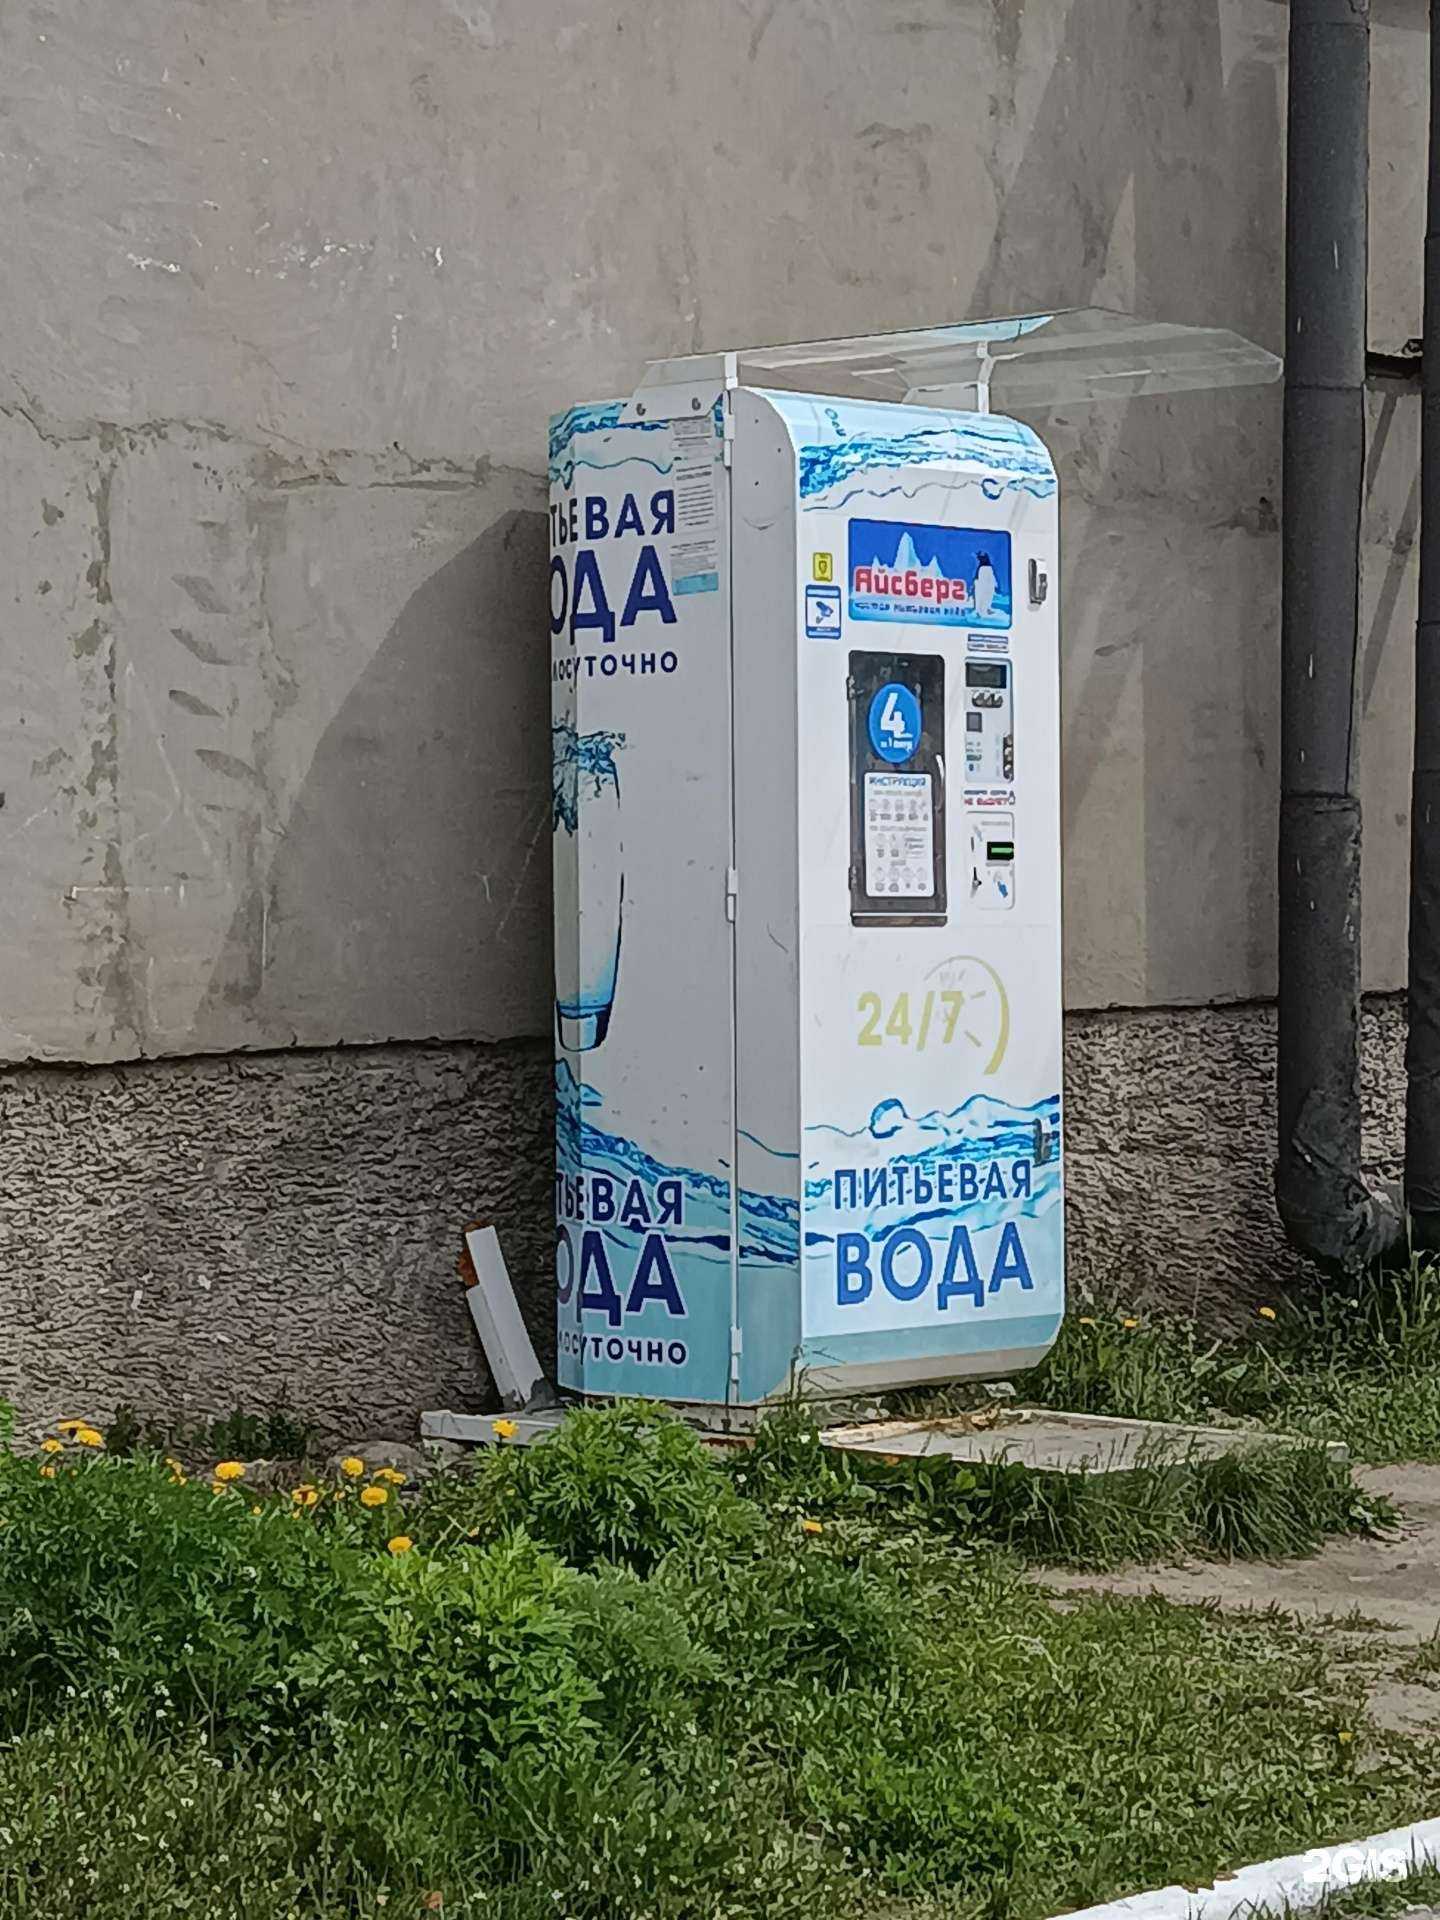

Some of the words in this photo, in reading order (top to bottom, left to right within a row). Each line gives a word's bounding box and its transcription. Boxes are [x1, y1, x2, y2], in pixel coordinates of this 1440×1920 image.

[550, 545, 678, 646] ОДА
[855, 568, 967, 603] Айсберг
[880, 692, 906, 739] 4
[857, 990, 964, 1052] 24/7
[834, 1159, 1031, 1210] ПИТЬЕВАЯ
[836, 1221, 1034, 1311] ВОДА
